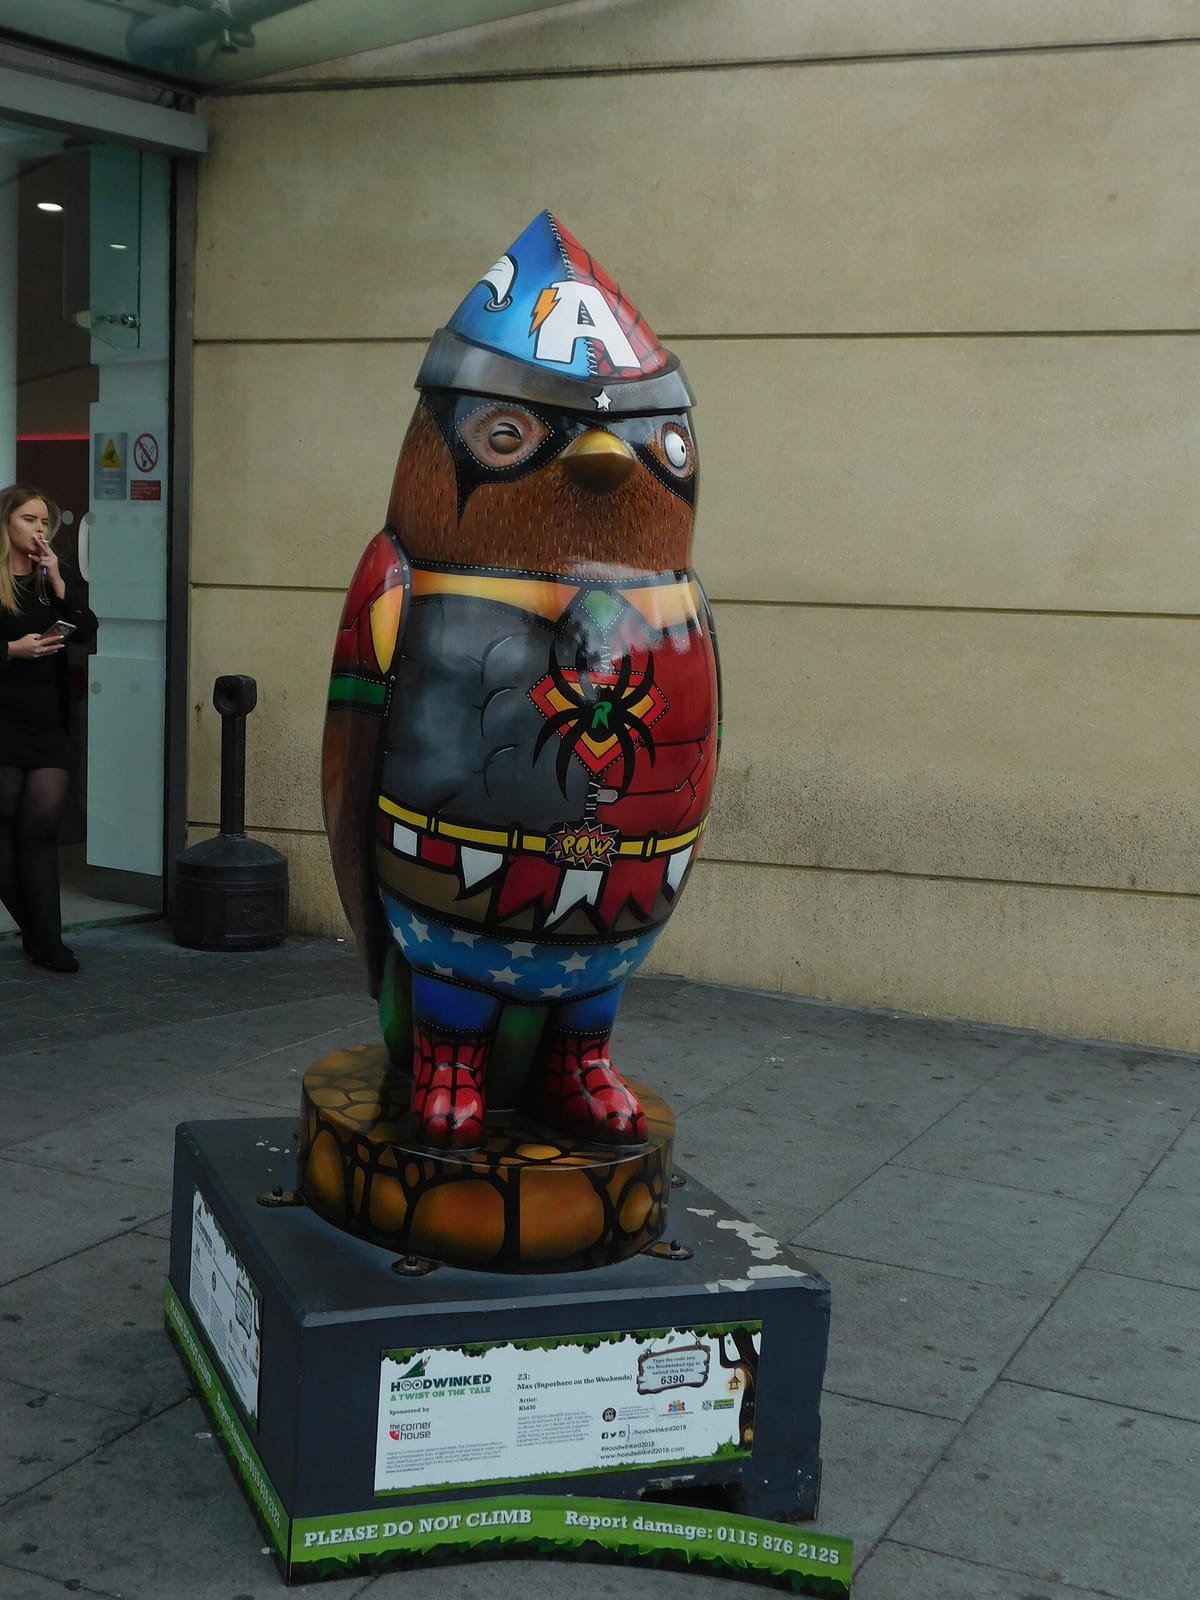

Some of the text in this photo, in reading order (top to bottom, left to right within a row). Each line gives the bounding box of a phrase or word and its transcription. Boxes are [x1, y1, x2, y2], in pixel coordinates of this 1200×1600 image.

[534, 279, 643, 370] A
[590, 701, 613, 729] R
[562, 835, 613, 856] POW
[390, 1373, 492, 1393] HOODWINKED
[516, 1383, 533, 1391] Max
[534, 1380, 573, 1390] (Superhero
[583, 1377, 595, 1385] the
[596, 1374, 633, 1383] Weekends)
[517, 1373, 531, 1381] 23:
[660, 1374, 685, 1385] 6390
[389, 1386, 492, 1402] A TWIST ON THE TALE
[389, 1407, 421, 1416] Sponsored
[400, 1422, 432, 1432] corner
[400, 1430, 431, 1441] house
[599, 1446, 685, 1460] www.hoodwinked2018.com
[304, 1509, 533, 1548] PLEASE DO NOT CLIMB
[564, 1510, 841, 1565] Report damage: 0115 876 2125
